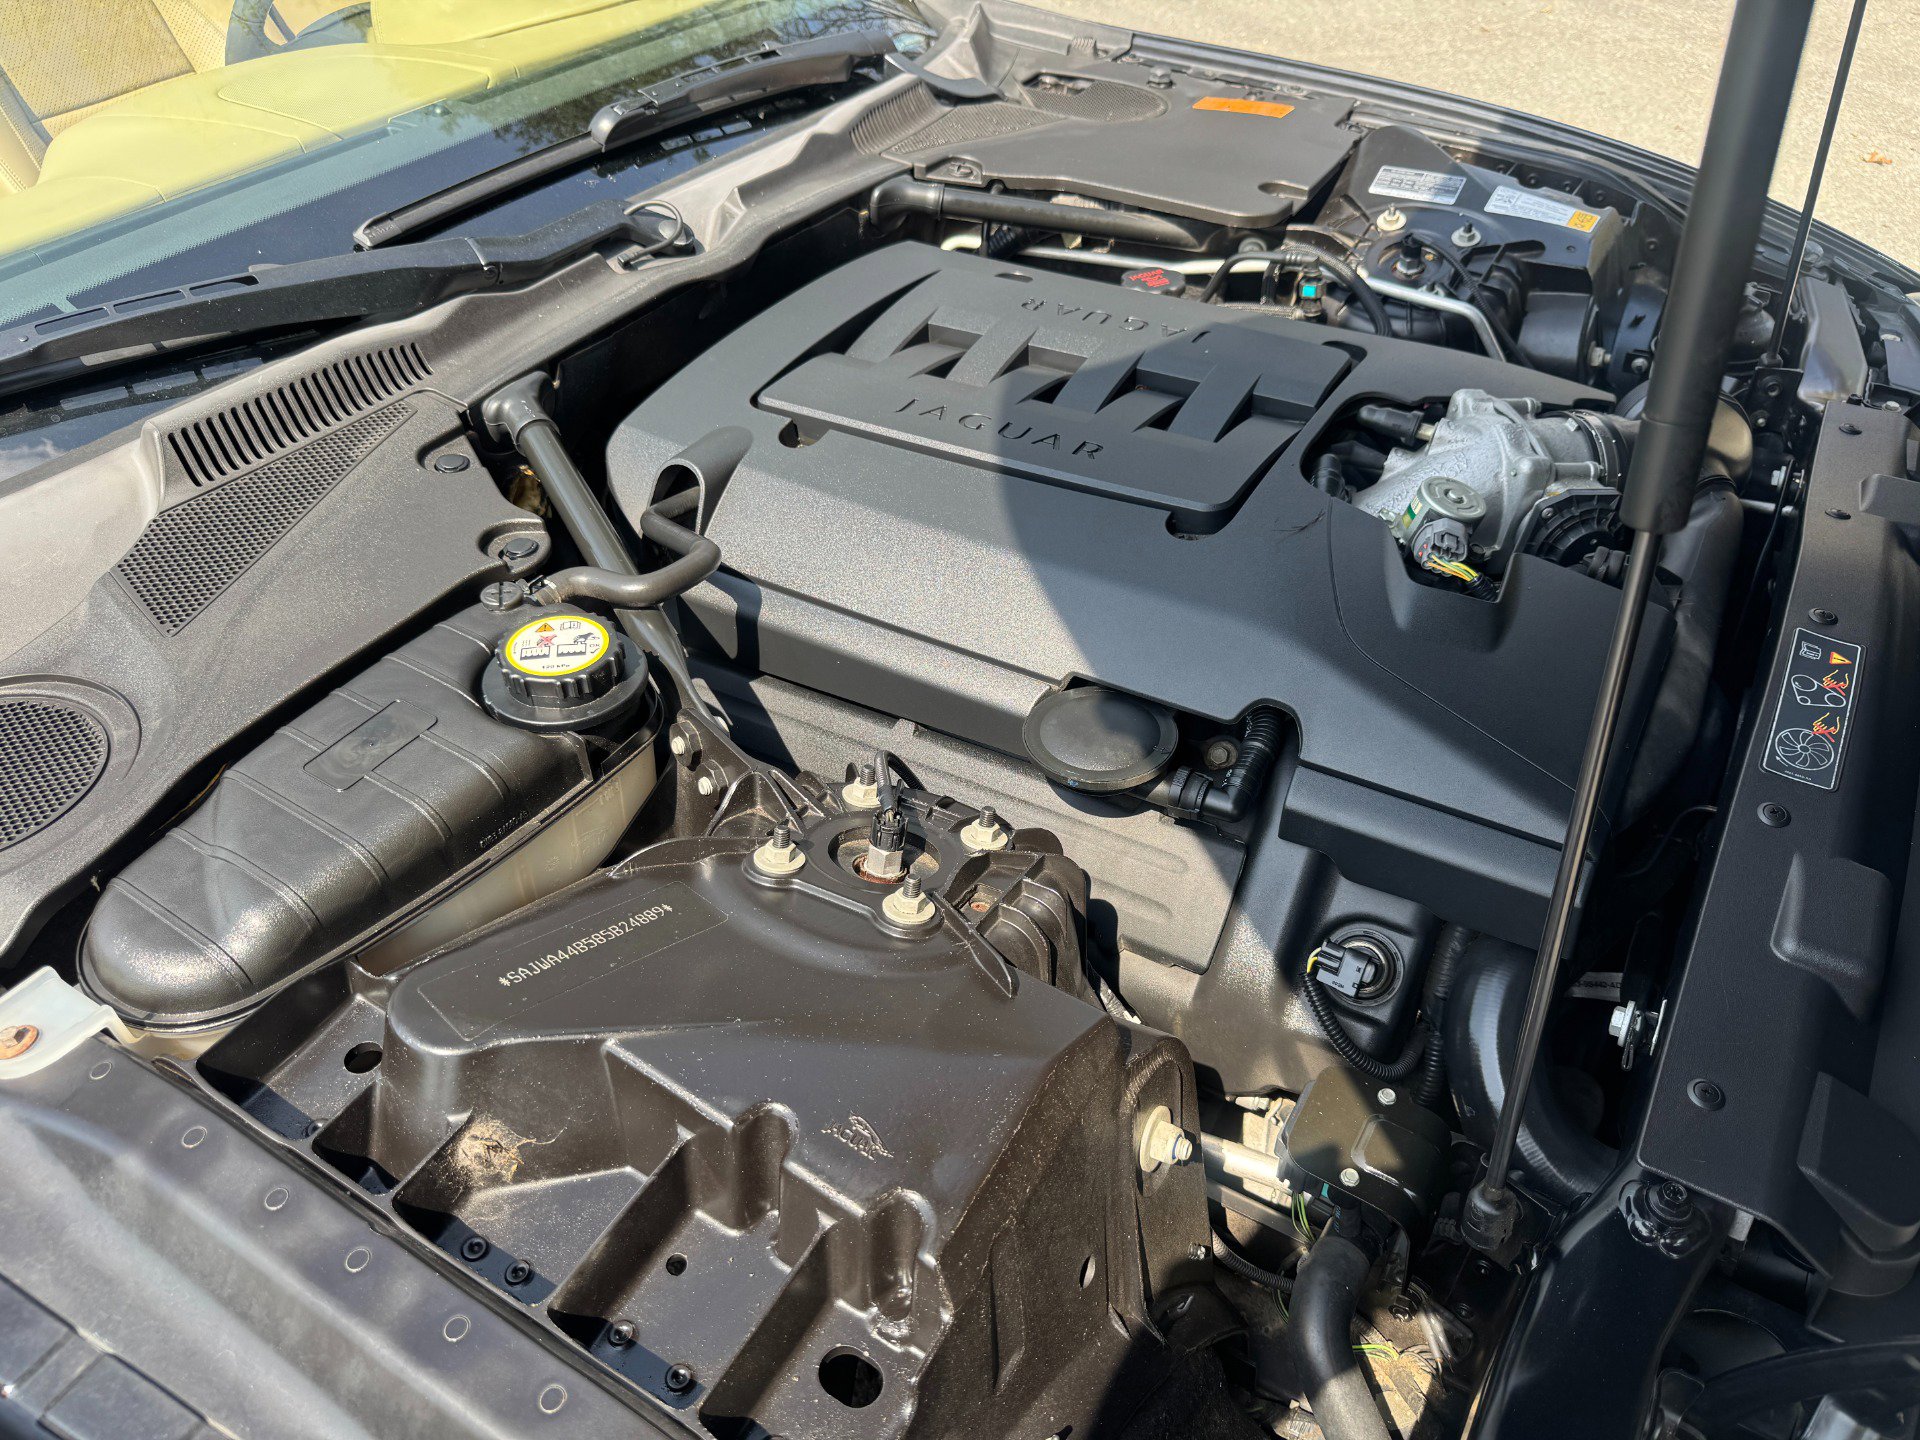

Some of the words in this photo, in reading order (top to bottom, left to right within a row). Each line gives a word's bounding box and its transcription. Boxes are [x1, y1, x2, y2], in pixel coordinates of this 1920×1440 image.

[1021, 297, 1211, 343] JAGUAR
[896, 397, 1104, 459] JAGUAR
[820, 1118, 877, 1161] JAGUAR
